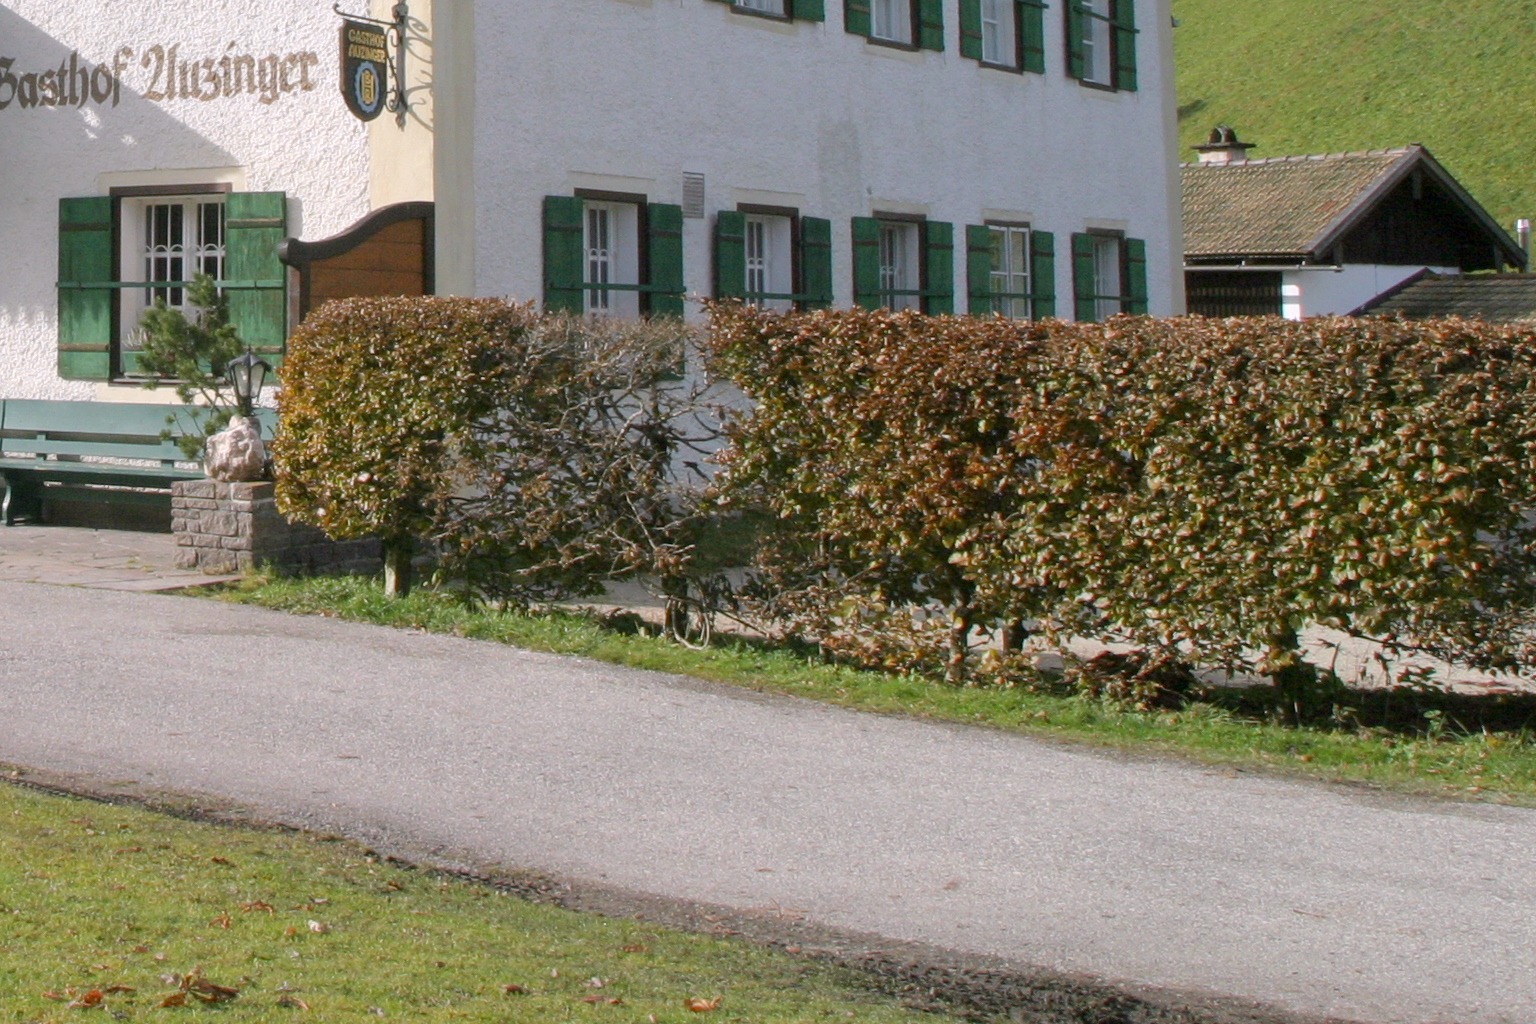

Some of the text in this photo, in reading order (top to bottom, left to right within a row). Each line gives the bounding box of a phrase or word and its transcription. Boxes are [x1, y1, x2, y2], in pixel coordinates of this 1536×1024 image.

[348, 29, 385, 48] GASTHOF
[348, 44, 386, 64] AUZINGER
[140, 40, 319, 105] Auzinger
